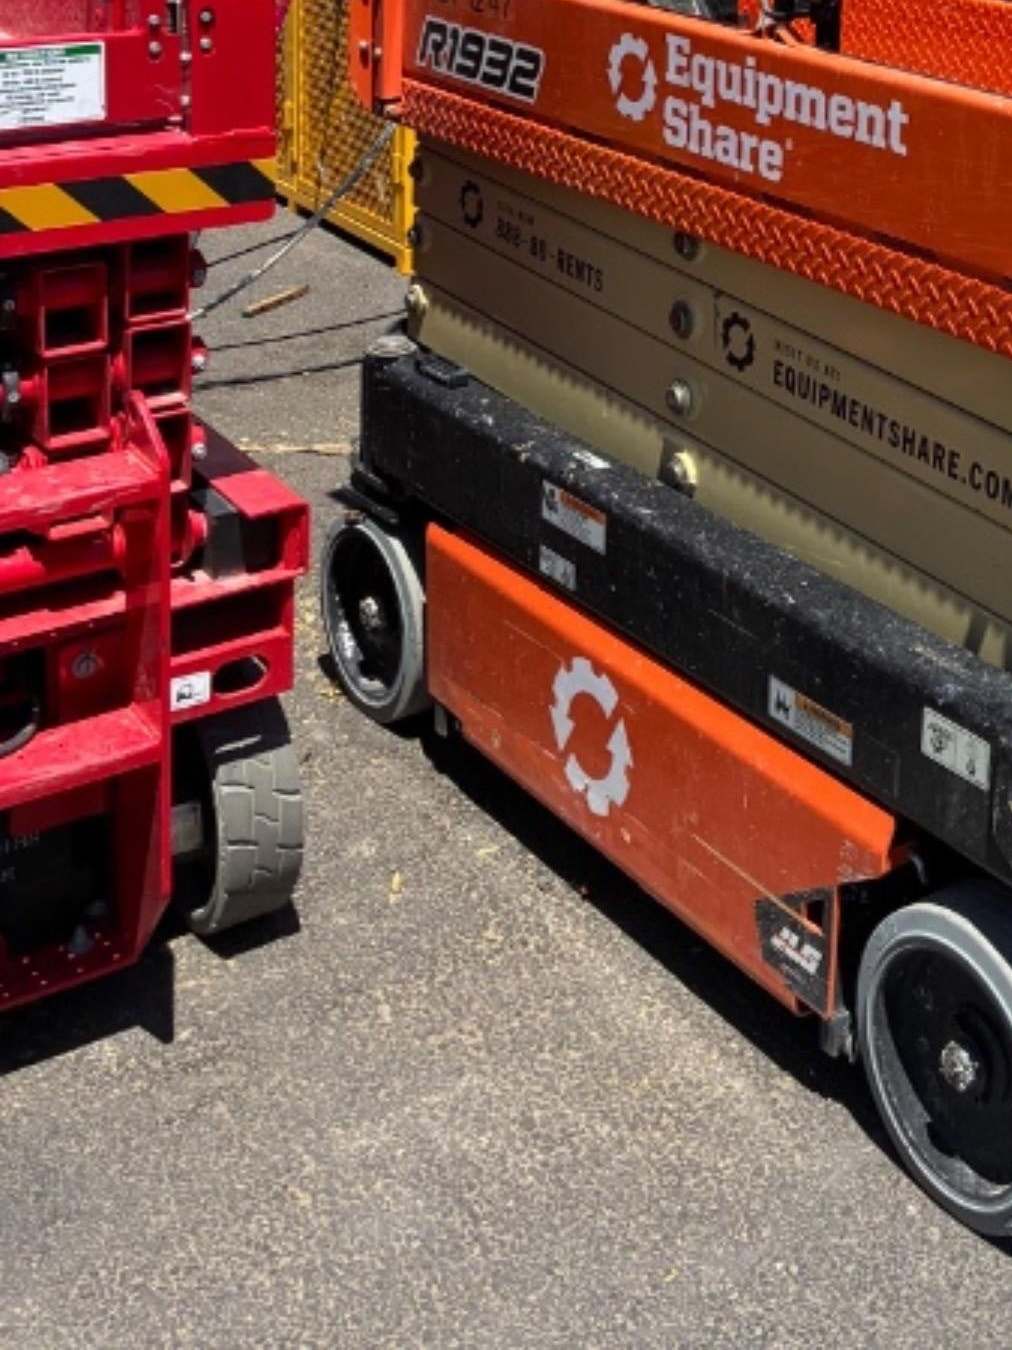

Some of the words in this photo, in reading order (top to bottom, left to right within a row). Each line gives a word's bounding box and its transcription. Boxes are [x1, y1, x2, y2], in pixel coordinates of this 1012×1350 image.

[417, 16, 545, 103] R1932
[665, 32, 908, 156] Equipment
[663, 96, 784, 182] Share
